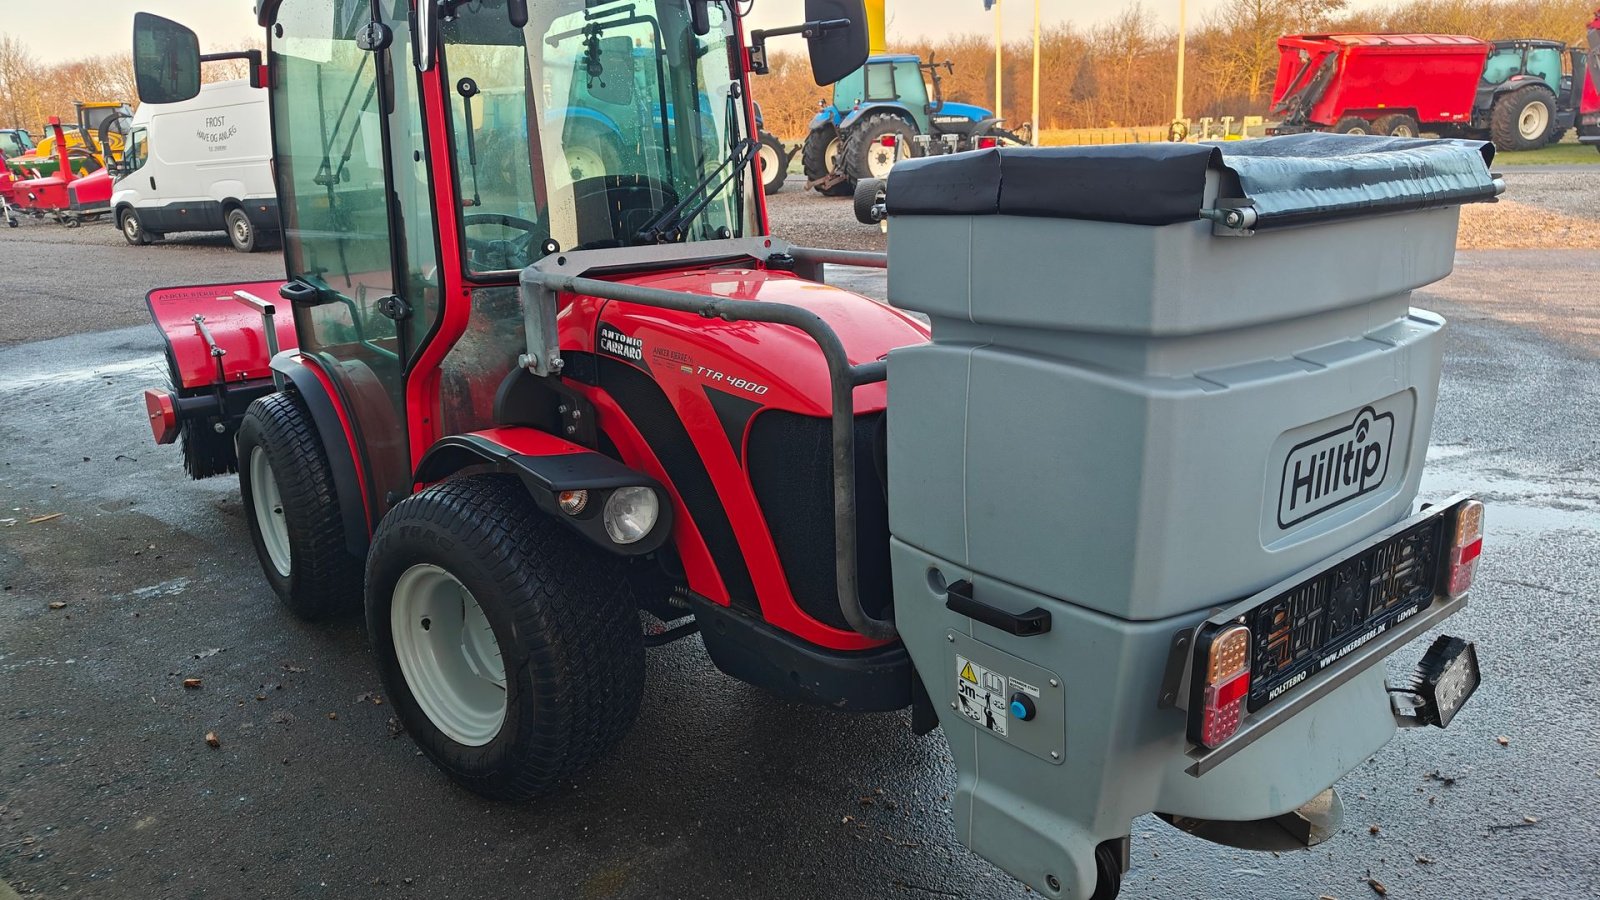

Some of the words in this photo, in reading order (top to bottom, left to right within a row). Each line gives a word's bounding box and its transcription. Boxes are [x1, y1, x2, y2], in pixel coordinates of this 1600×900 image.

[206, 116, 224, 127] FROST
[196, 130, 209, 142] HAVE
[210, 133, 218, 142] OG
[601, 328, 643, 347] ANTONIO
[600, 338, 643, 360] CARRARO
[697, 366, 723, 382] TTR
[726, 375, 769, 396] 4800
[1289, 421, 1382, 511] Hilltip
[1268, 670, 1307, 701] HOLSTEBRO
[1319, 623, 1387, 669] WWW.ANKERBJERRE.DK
[1397, 604, 1419, 623] LEMVIG
[958, 679, 976, 700] 5m
